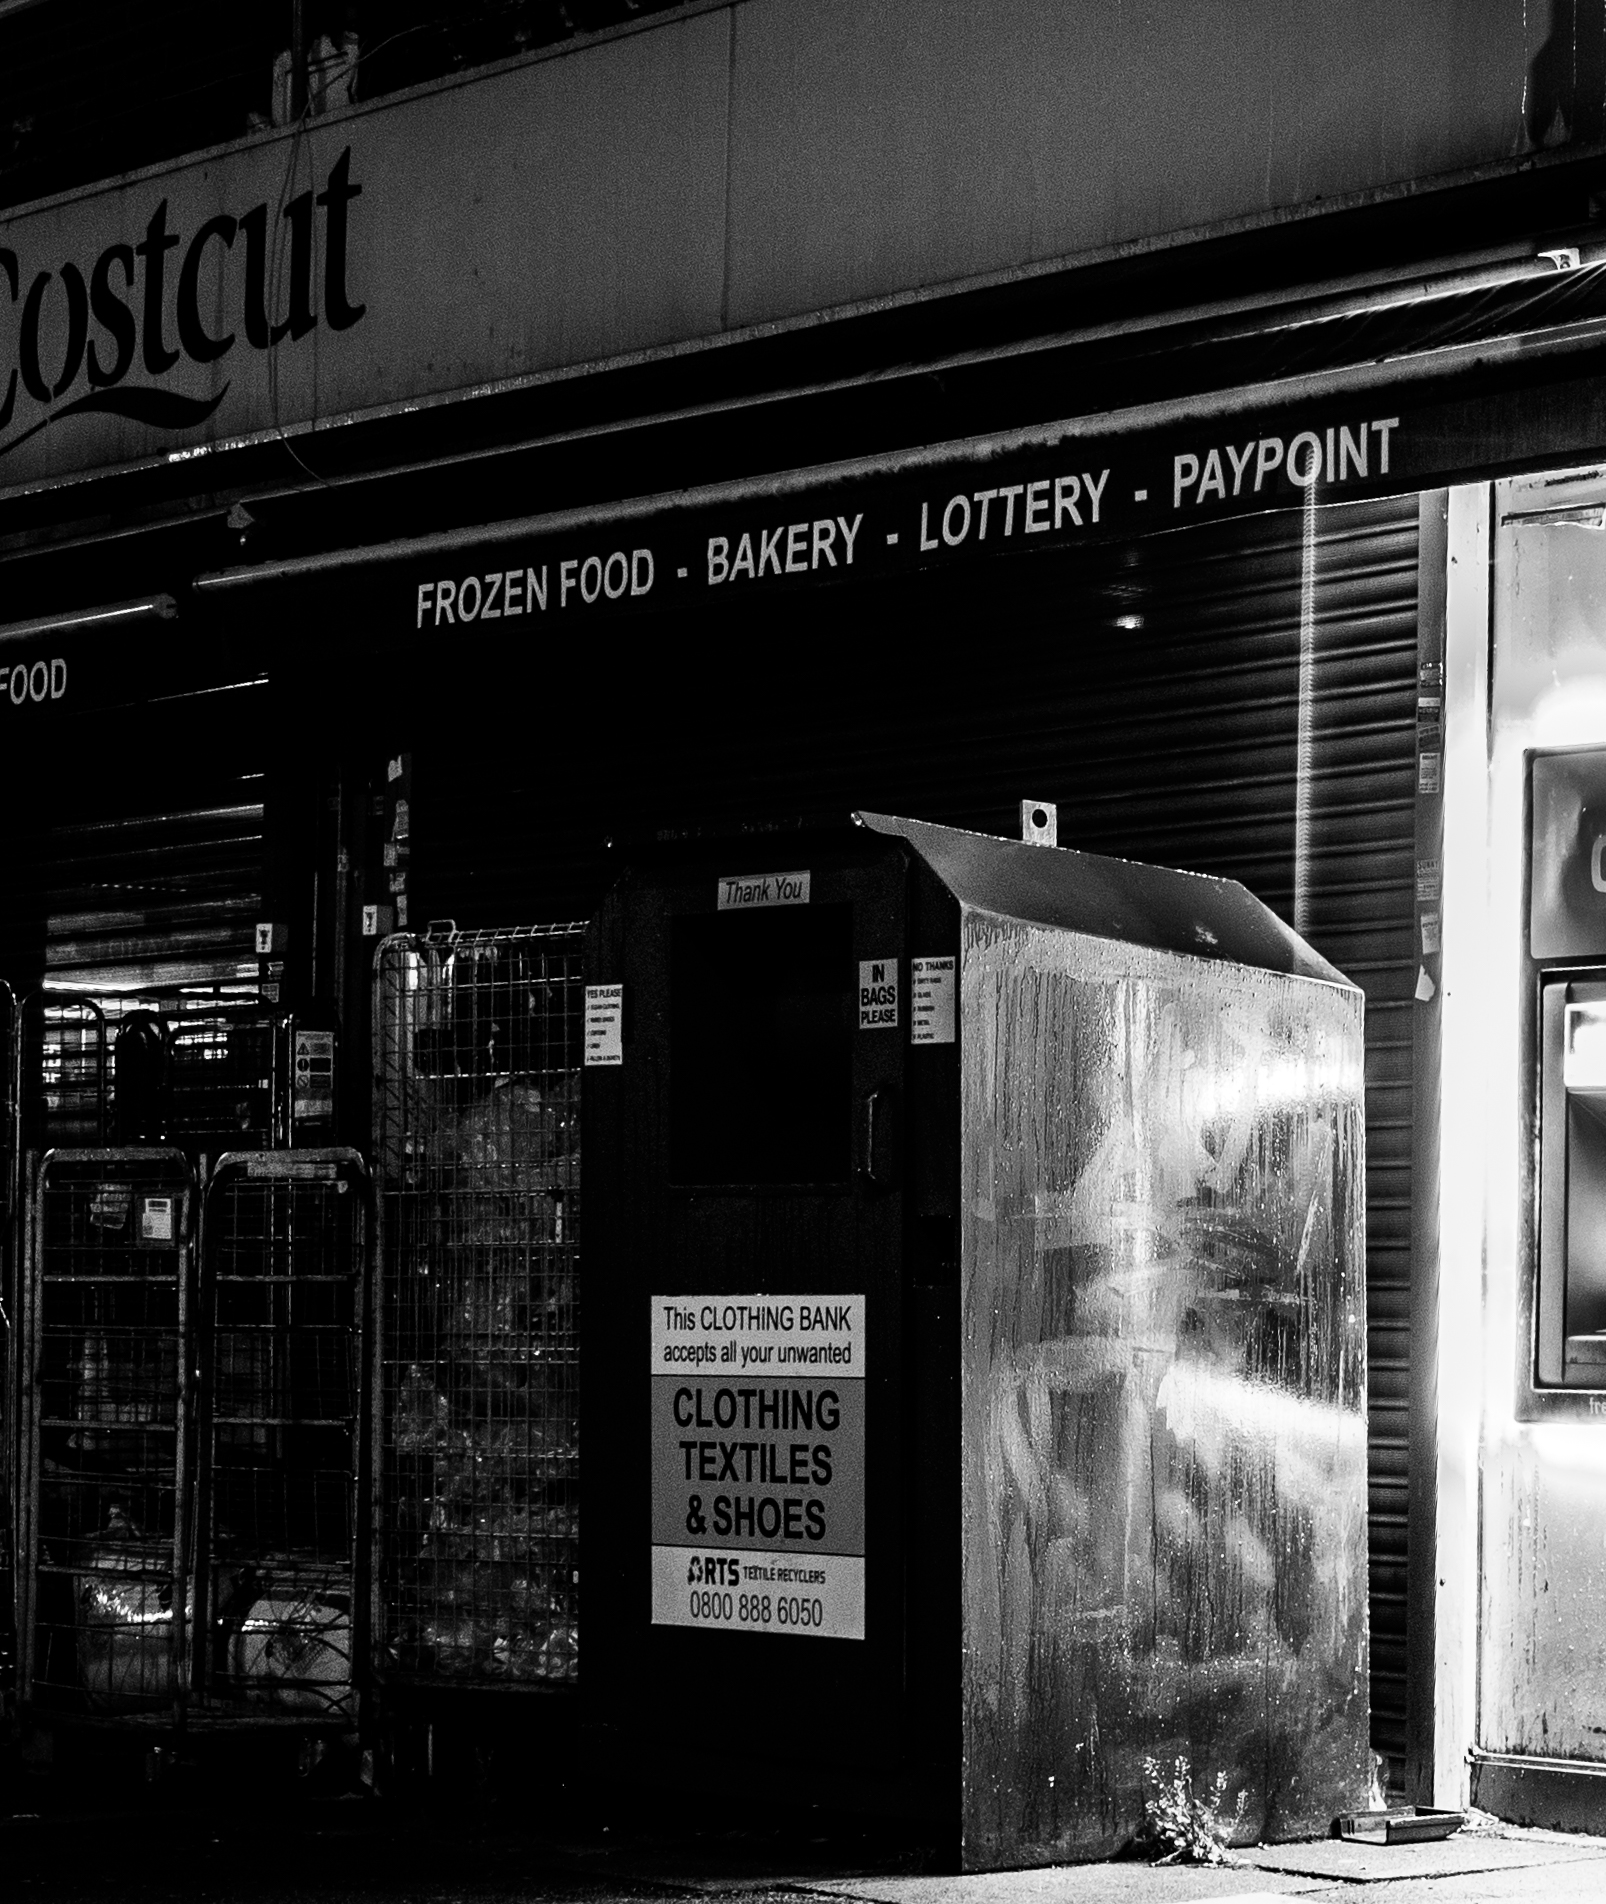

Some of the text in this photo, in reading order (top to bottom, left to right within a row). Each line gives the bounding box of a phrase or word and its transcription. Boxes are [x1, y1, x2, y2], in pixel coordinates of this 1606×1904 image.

[416, 565, 549, 629] FROZEN
[559, 548, 655, 609] FOOD
[706, 513, 864, 587] BAKERY
[919, 470, 1110, 553] LOTTERY
[1172, 418, 1400, 508] PAYPOINT
[725, 877, 802, 906] Thank You
[872, 963, 885, 983] IN
[913, 959, 953, 972] NO THANKS
[588, 987, 621, 999] YES PLEASE
[861, 985, 896, 1006] BAGS
[861, 1008, 896, 1025] PLEASE
[663, 1305, 696, 1331] This
[799, 1305, 852, 1332] BANK
[663, 1339, 852, 1369] accepts all your unwanted
[673, 1387, 841, 1431] CLOTHING
[679, 1441, 833, 1486] TEXTILES
[686, 1494, 826, 1540] & SHOES
[704, 1556, 827, 1586] RTS TEXTILE RECYCLERS
[690, 1590, 823, 1627] 0800 888 6050
